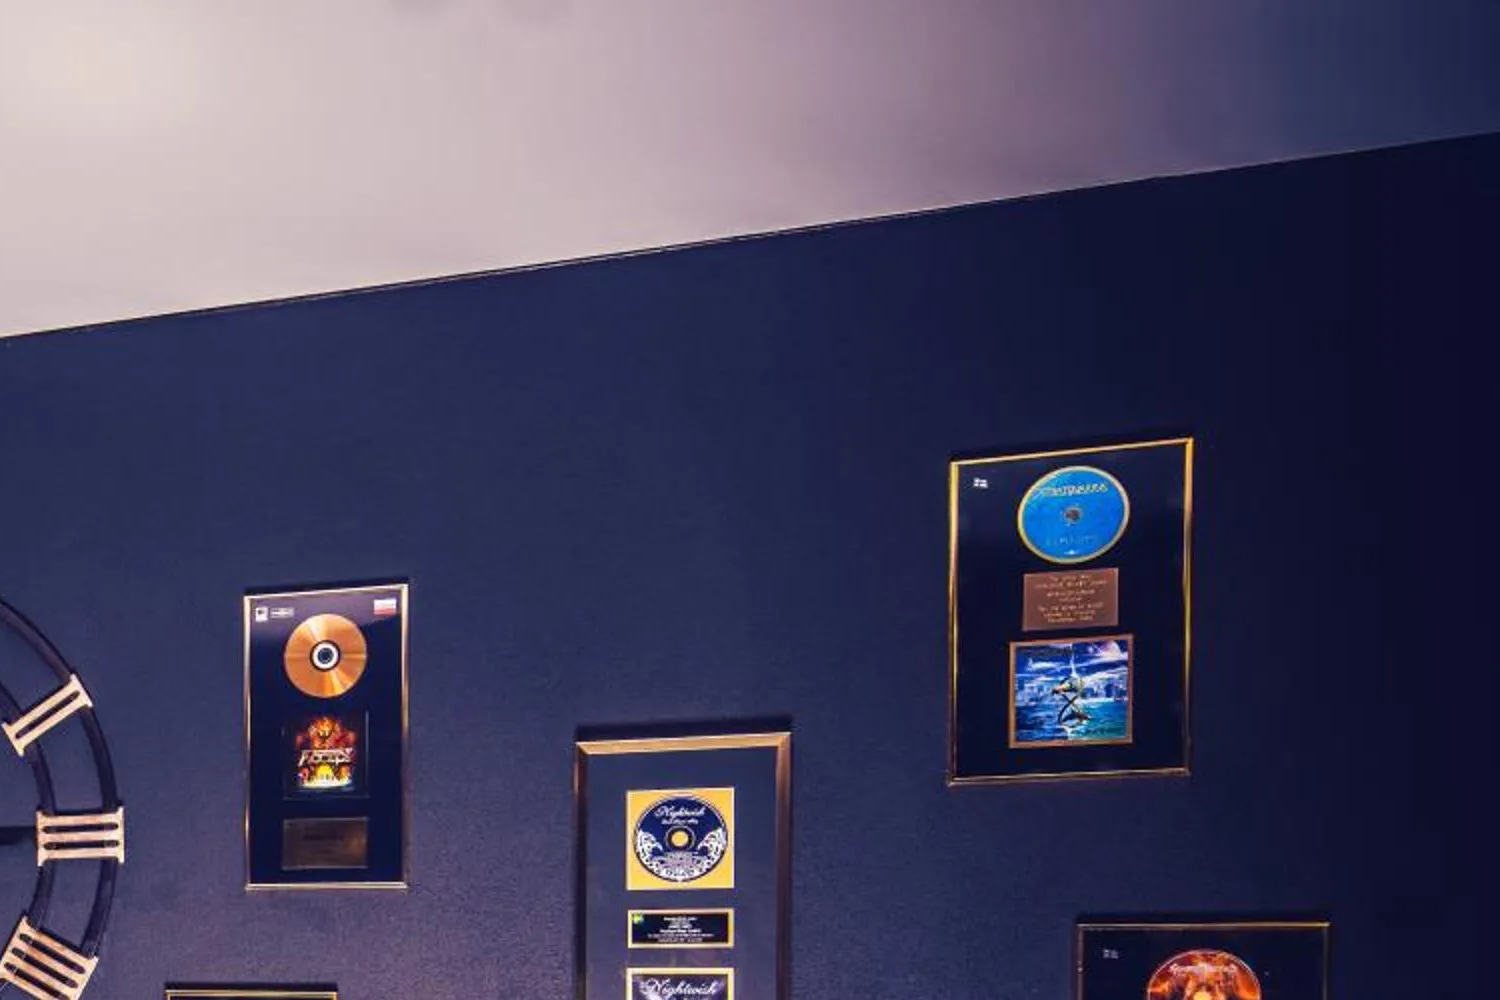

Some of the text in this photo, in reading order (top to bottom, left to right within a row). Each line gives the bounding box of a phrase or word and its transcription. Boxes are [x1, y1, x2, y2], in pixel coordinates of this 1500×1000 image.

[2, 673, 94, 757] II
[36, 805, 125, 867] III
[641, 978, 718, 999] Nightwish
